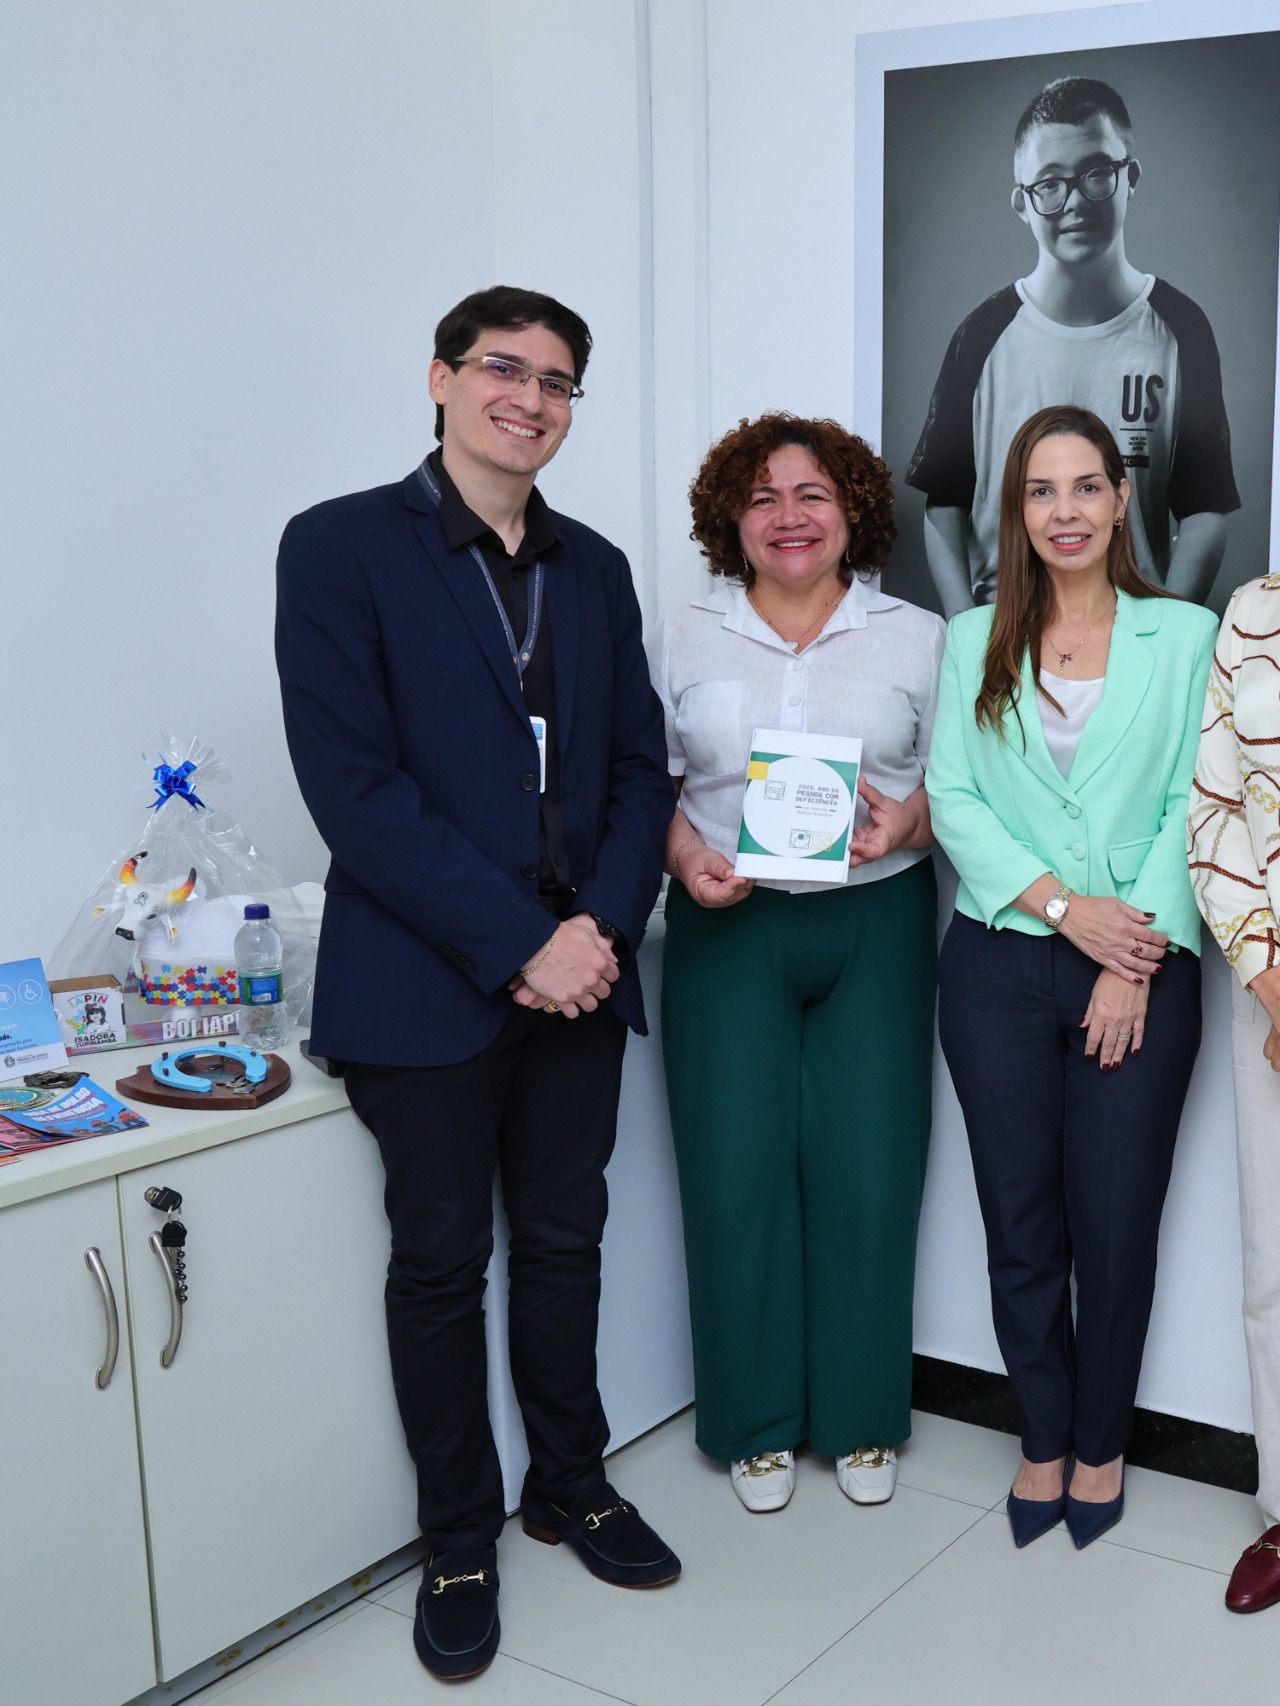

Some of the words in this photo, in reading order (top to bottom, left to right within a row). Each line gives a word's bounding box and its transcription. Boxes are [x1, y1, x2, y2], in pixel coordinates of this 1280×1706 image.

[1121, 374, 1164, 423] US
[796, 790, 823, 798] PESSOA
[74, 1032, 116, 1043] ISADORA
[162, 1017, 197, 1041] BOI
[60, 1086, 92, 1106] BOLSO
